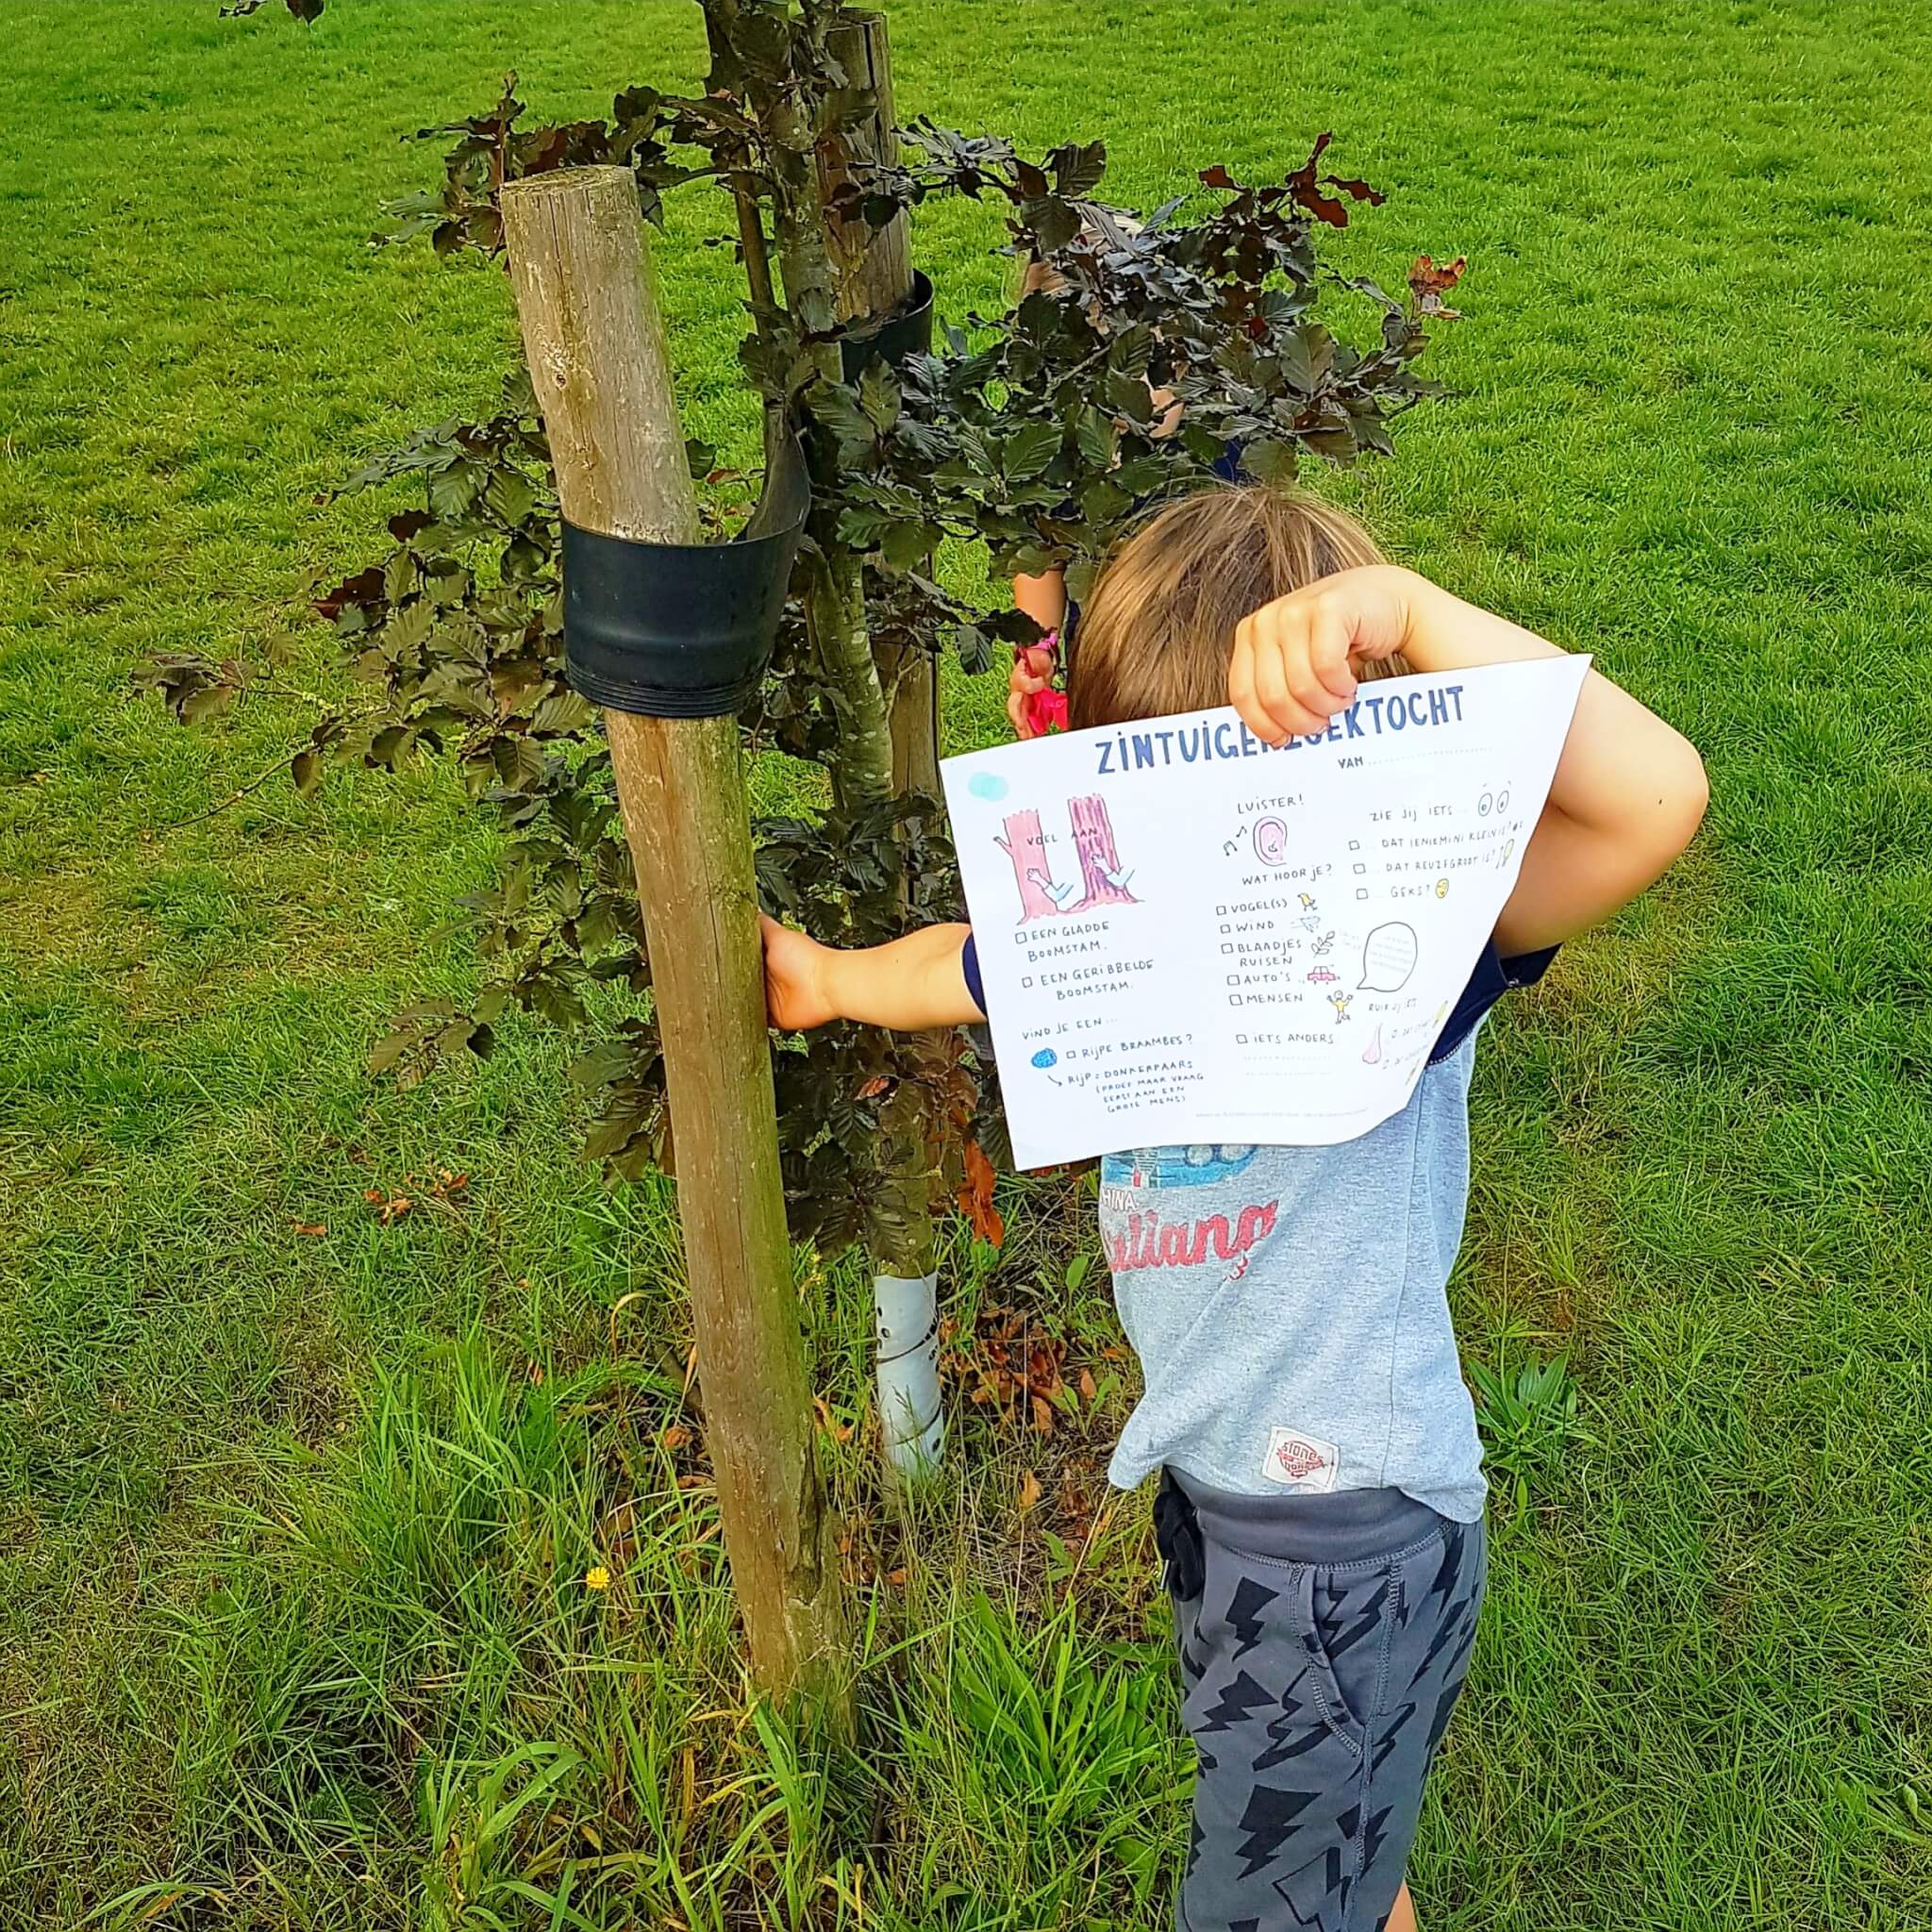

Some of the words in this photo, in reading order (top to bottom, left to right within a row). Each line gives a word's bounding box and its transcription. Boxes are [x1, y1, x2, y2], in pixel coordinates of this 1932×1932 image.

[1338, 756, 1364, 770] VAN
[1237, 793, 1305, 814] LUISTER!
[1369, 809, 1392, 822] ZIE
[1401, 808, 1418, 823] JIJ
[1026, 834, 1058, 847] VOEL
[1071, 827, 1098, 840] AAN
[1381, 838, 1405, 849] DAT
[1241, 874, 1269, 886] WAT
[1274, 868, 1307, 882] HOOR
[1309, 862, 1333, 882] JE?
[1385, 861, 1409, 873] DAT
[1230, 898, 1289, 914] VOGEL(S)
[1031, 926, 1058, 941] EEN
[1062, 920, 1110, 938] GLADDE
[1236, 920, 1275, 933] WIND
[1027, 940, 1108, 963] BOOMSTAM.
[1237, 938, 1303, 956] BLAADJES
[1239, 956, 1293, 968] RUISEN
[1040, 971, 1068, 987] EEN
[1072, 958, 1155, 982] GERIBBELDE
[1243, 970, 1291, 985] AUTO'S
[1246, 992, 1304, 1005] MENSEN
[1022, 1025, 1052, 1041] VIND
[1056, 1021, 1069, 1036] JE
[1253, 1033, 1282, 1044] IETS
[1288, 1033, 1335, 1044] ANDERS
[1081, 1043, 1113, 1061] RIJPE
[1067, 1071, 1092, 1088] RIJP
[1137, 1076, 1168, 1086] MAAR
[1134, 1089, 1156, 1099] AAN
[1161, 1086, 1186, 1095] EEN
